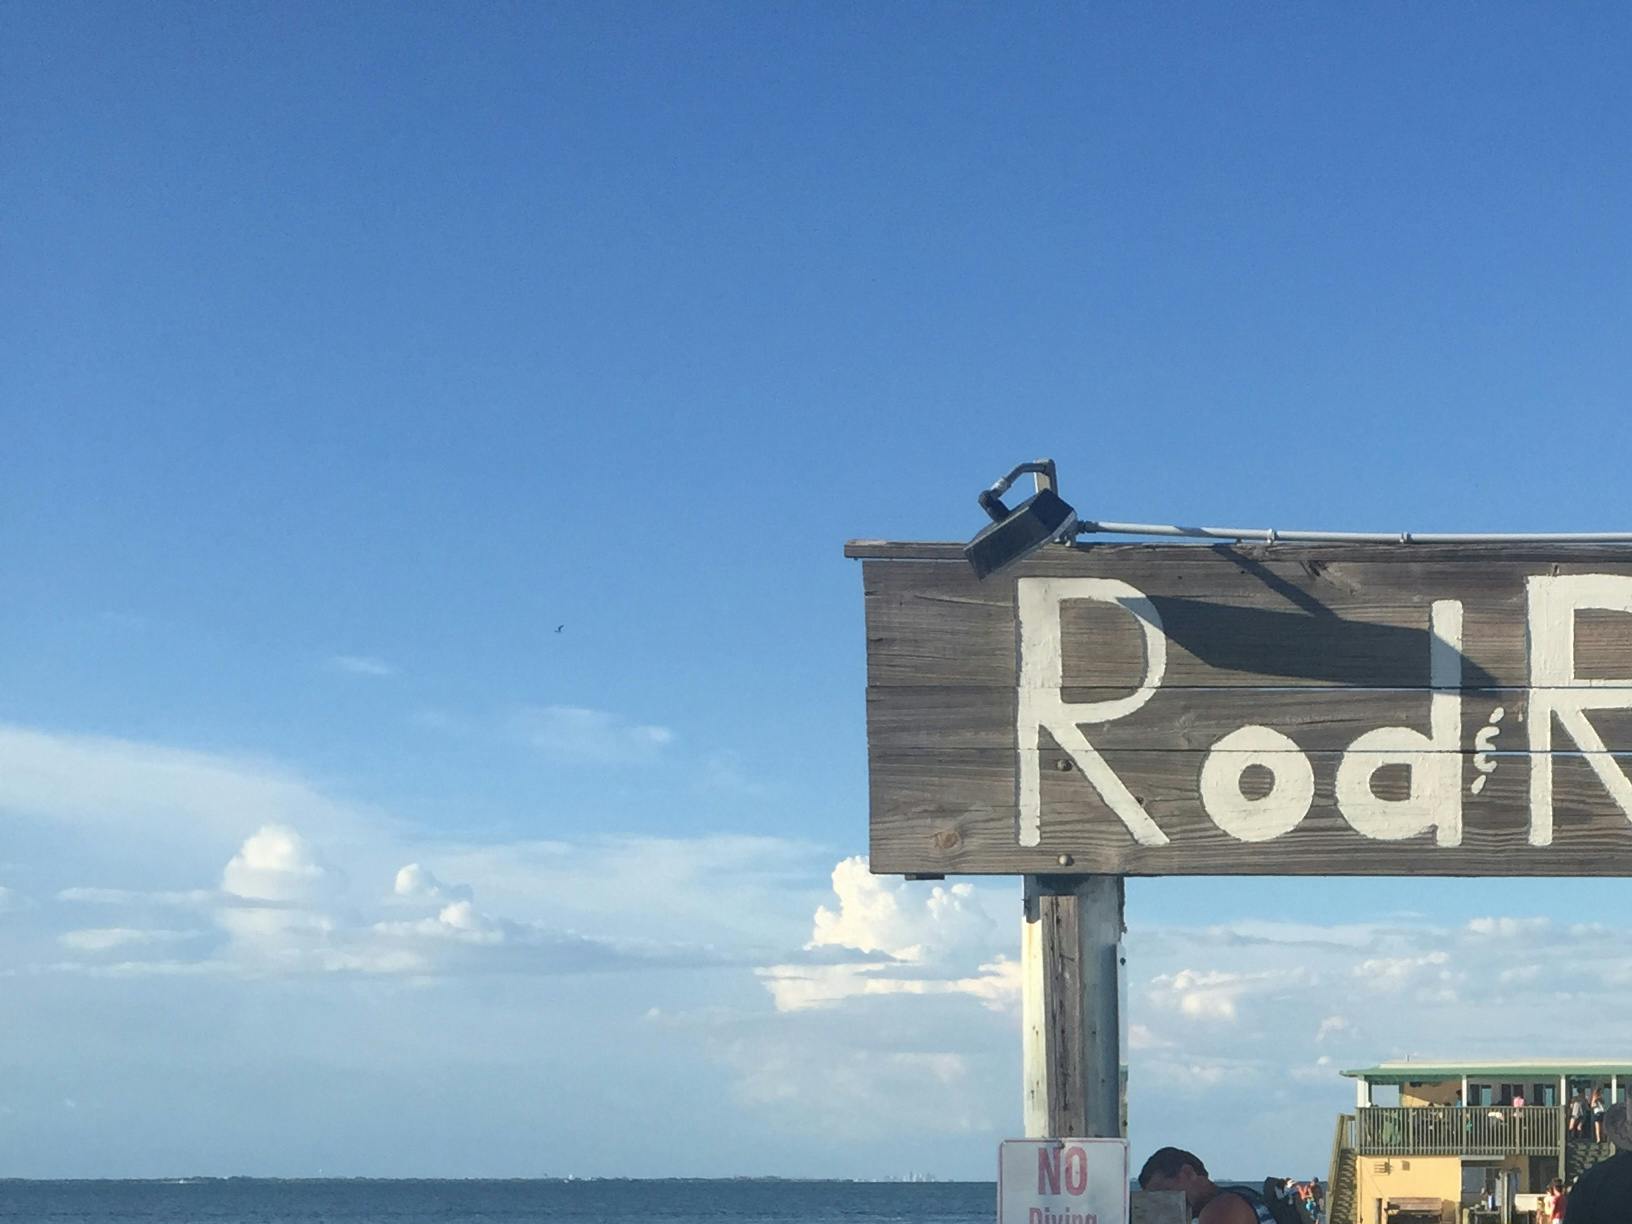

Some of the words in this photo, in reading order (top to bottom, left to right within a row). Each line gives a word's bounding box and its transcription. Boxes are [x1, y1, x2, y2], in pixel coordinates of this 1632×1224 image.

[1017, 577, 1463, 847] Rod
[1471, 706, 1505, 794] &
[1037, 1146, 1088, 1196] NO
